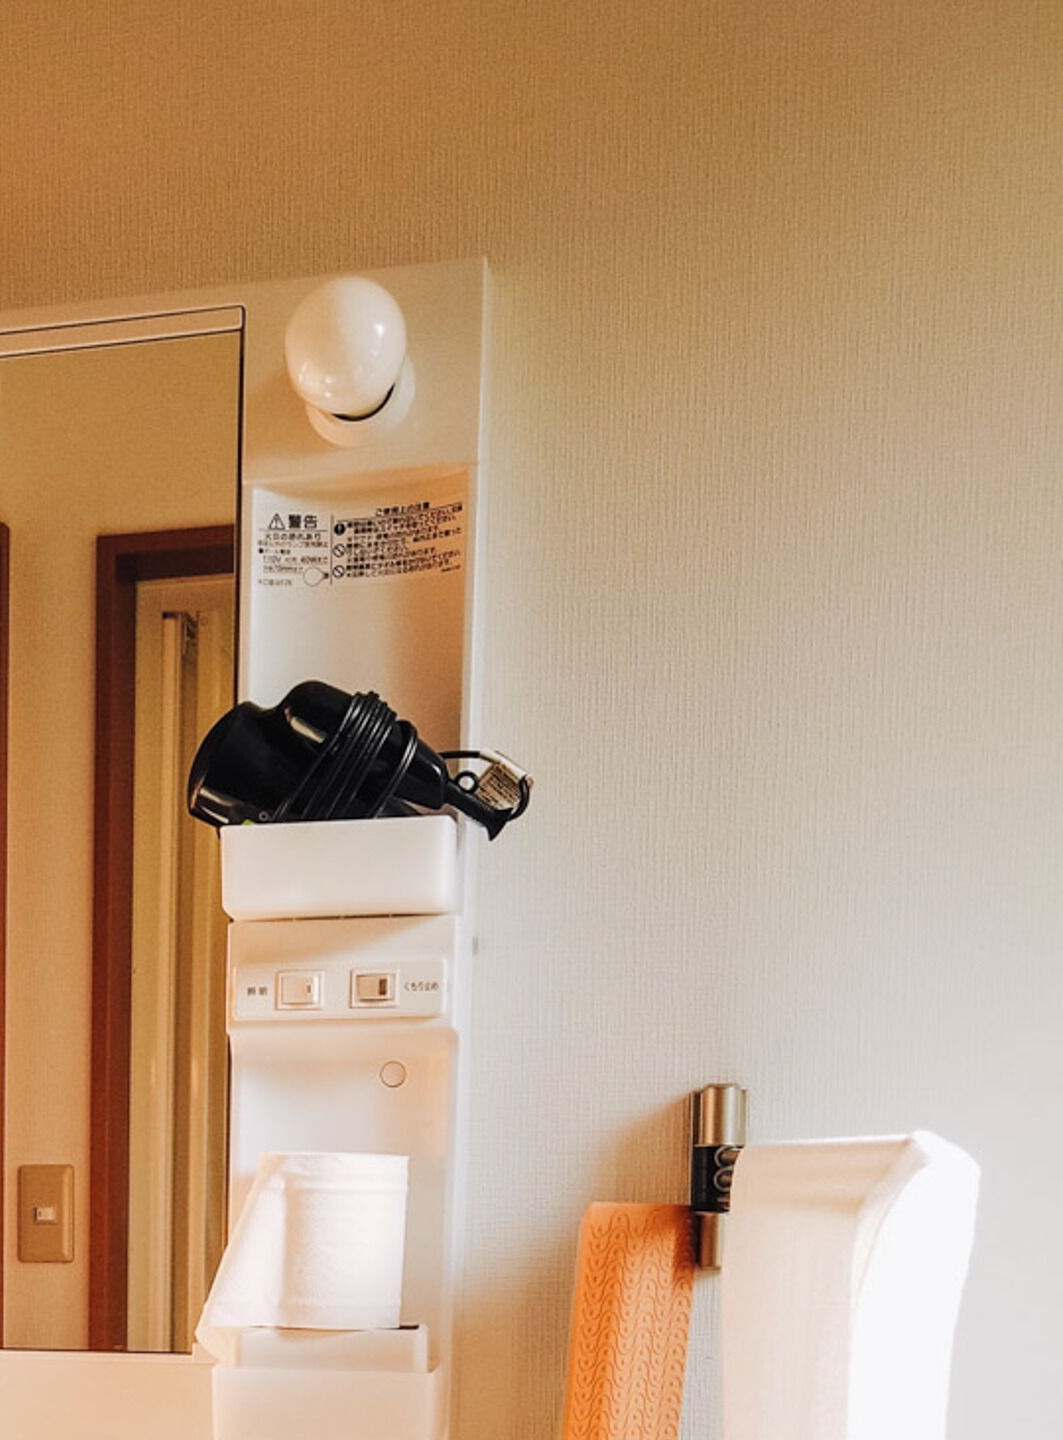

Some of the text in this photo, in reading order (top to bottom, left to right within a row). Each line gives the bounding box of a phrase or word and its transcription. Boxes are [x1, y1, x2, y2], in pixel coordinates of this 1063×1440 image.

[288, 514, 318, 530] 警告
[403, 980, 440, 992] くもり止め
